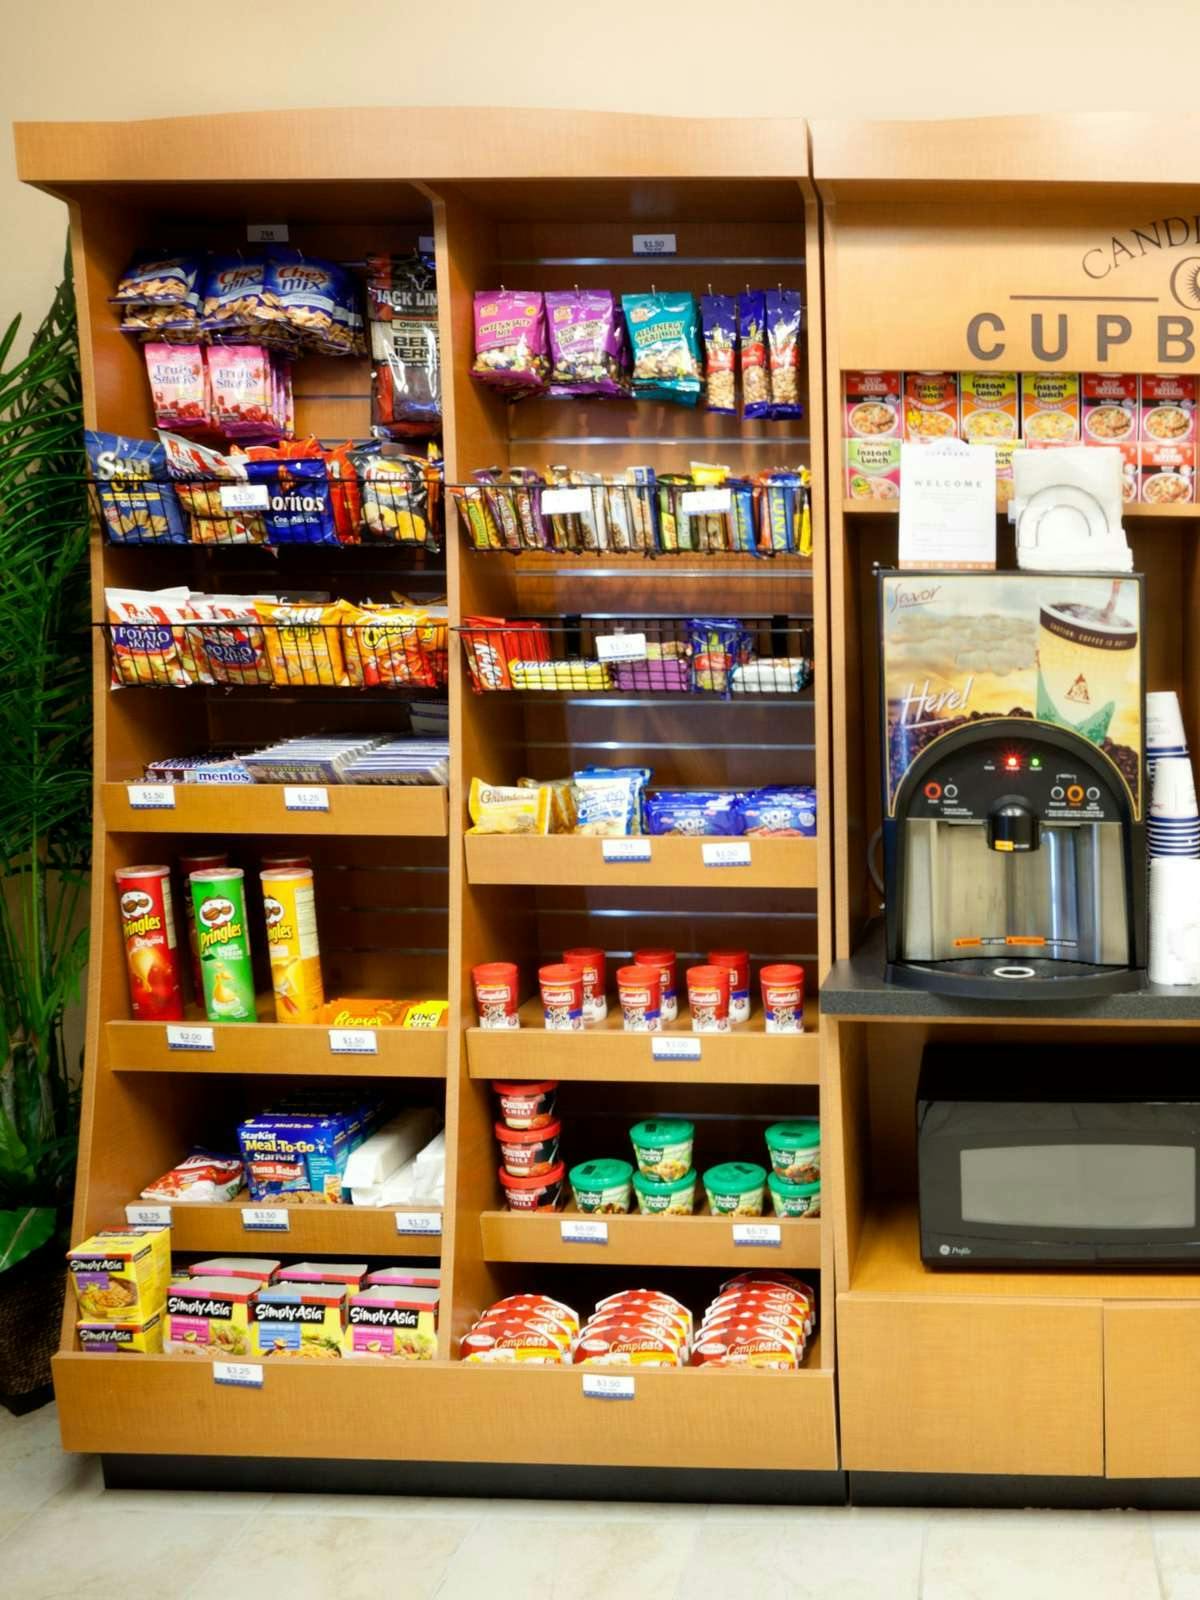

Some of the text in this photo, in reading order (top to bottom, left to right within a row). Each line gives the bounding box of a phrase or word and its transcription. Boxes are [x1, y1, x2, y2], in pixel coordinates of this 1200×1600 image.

[277, 264, 330, 283] Chex
[281, 277, 321, 291] mix
[975, 389, 1003, 397] Lunch
[1033, 383, 1068, 391] Instant
[1036, 391, 1064, 399] Lunch
[860, 456, 889, 465] Lunch
[914, 479, 984, 489] WELCOME
[266, 491, 325, 512] oritos
[891, 583, 942, 613] Savor
[119, 627, 171, 644] POTATO
[902, 676, 974, 727] Here!
[199, 771, 250, 783] mentos
[200, 922, 242, 953] Pringles
[409, 1012, 437, 1022] KING
[241, 1130, 277, 1141] StarKist
[69, 1259, 123, 1272] Simply Asia
[167, 1297, 231, 1317] Simply Asia
[255, 1303, 324, 1322] Simply Asia
[350, 1307, 418, 1326] Simply Asia
[79, 1329, 131, 1343] Simply Asia
[494, 1335, 549, 1350] Compleats
[608, 1340, 664, 1355] Compleats
